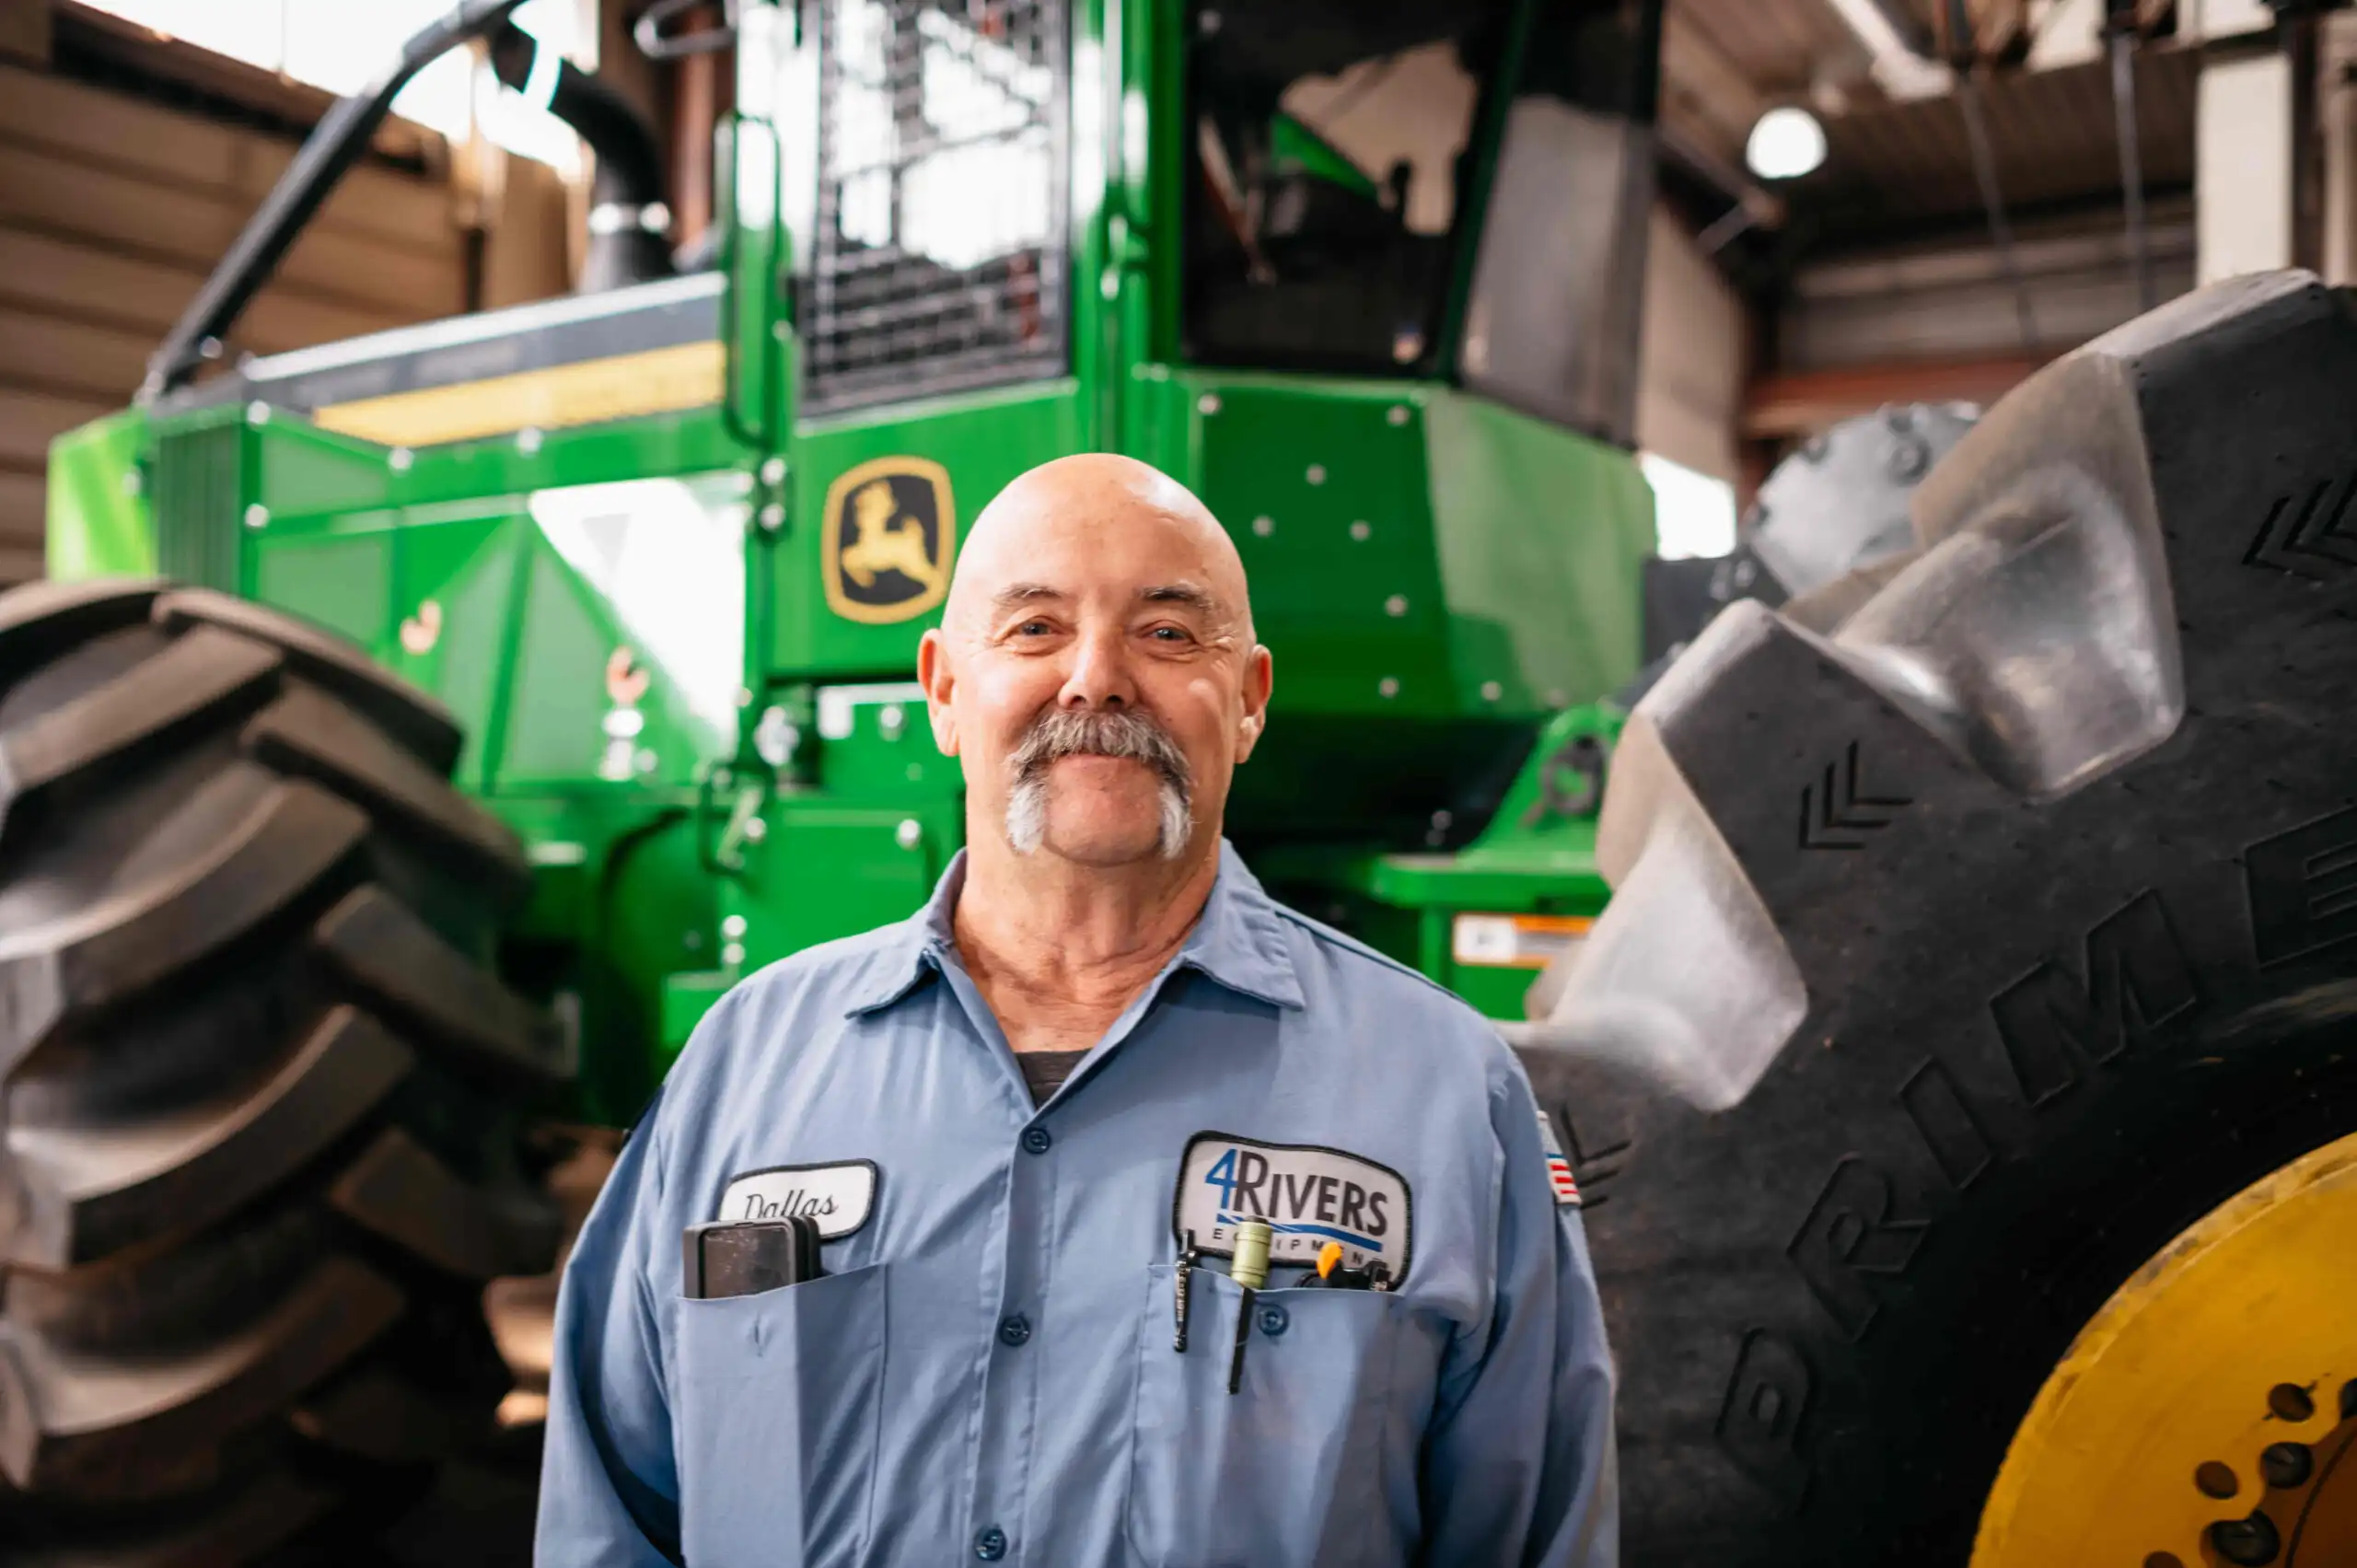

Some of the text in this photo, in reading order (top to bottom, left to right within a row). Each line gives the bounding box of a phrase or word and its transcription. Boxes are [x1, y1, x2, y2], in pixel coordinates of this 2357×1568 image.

[745, 1189, 839, 1220] Dallas
[1205, 1148, 1387, 1236] 4RIVERS
[1213, 1227, 1368, 1265] EIPMN
